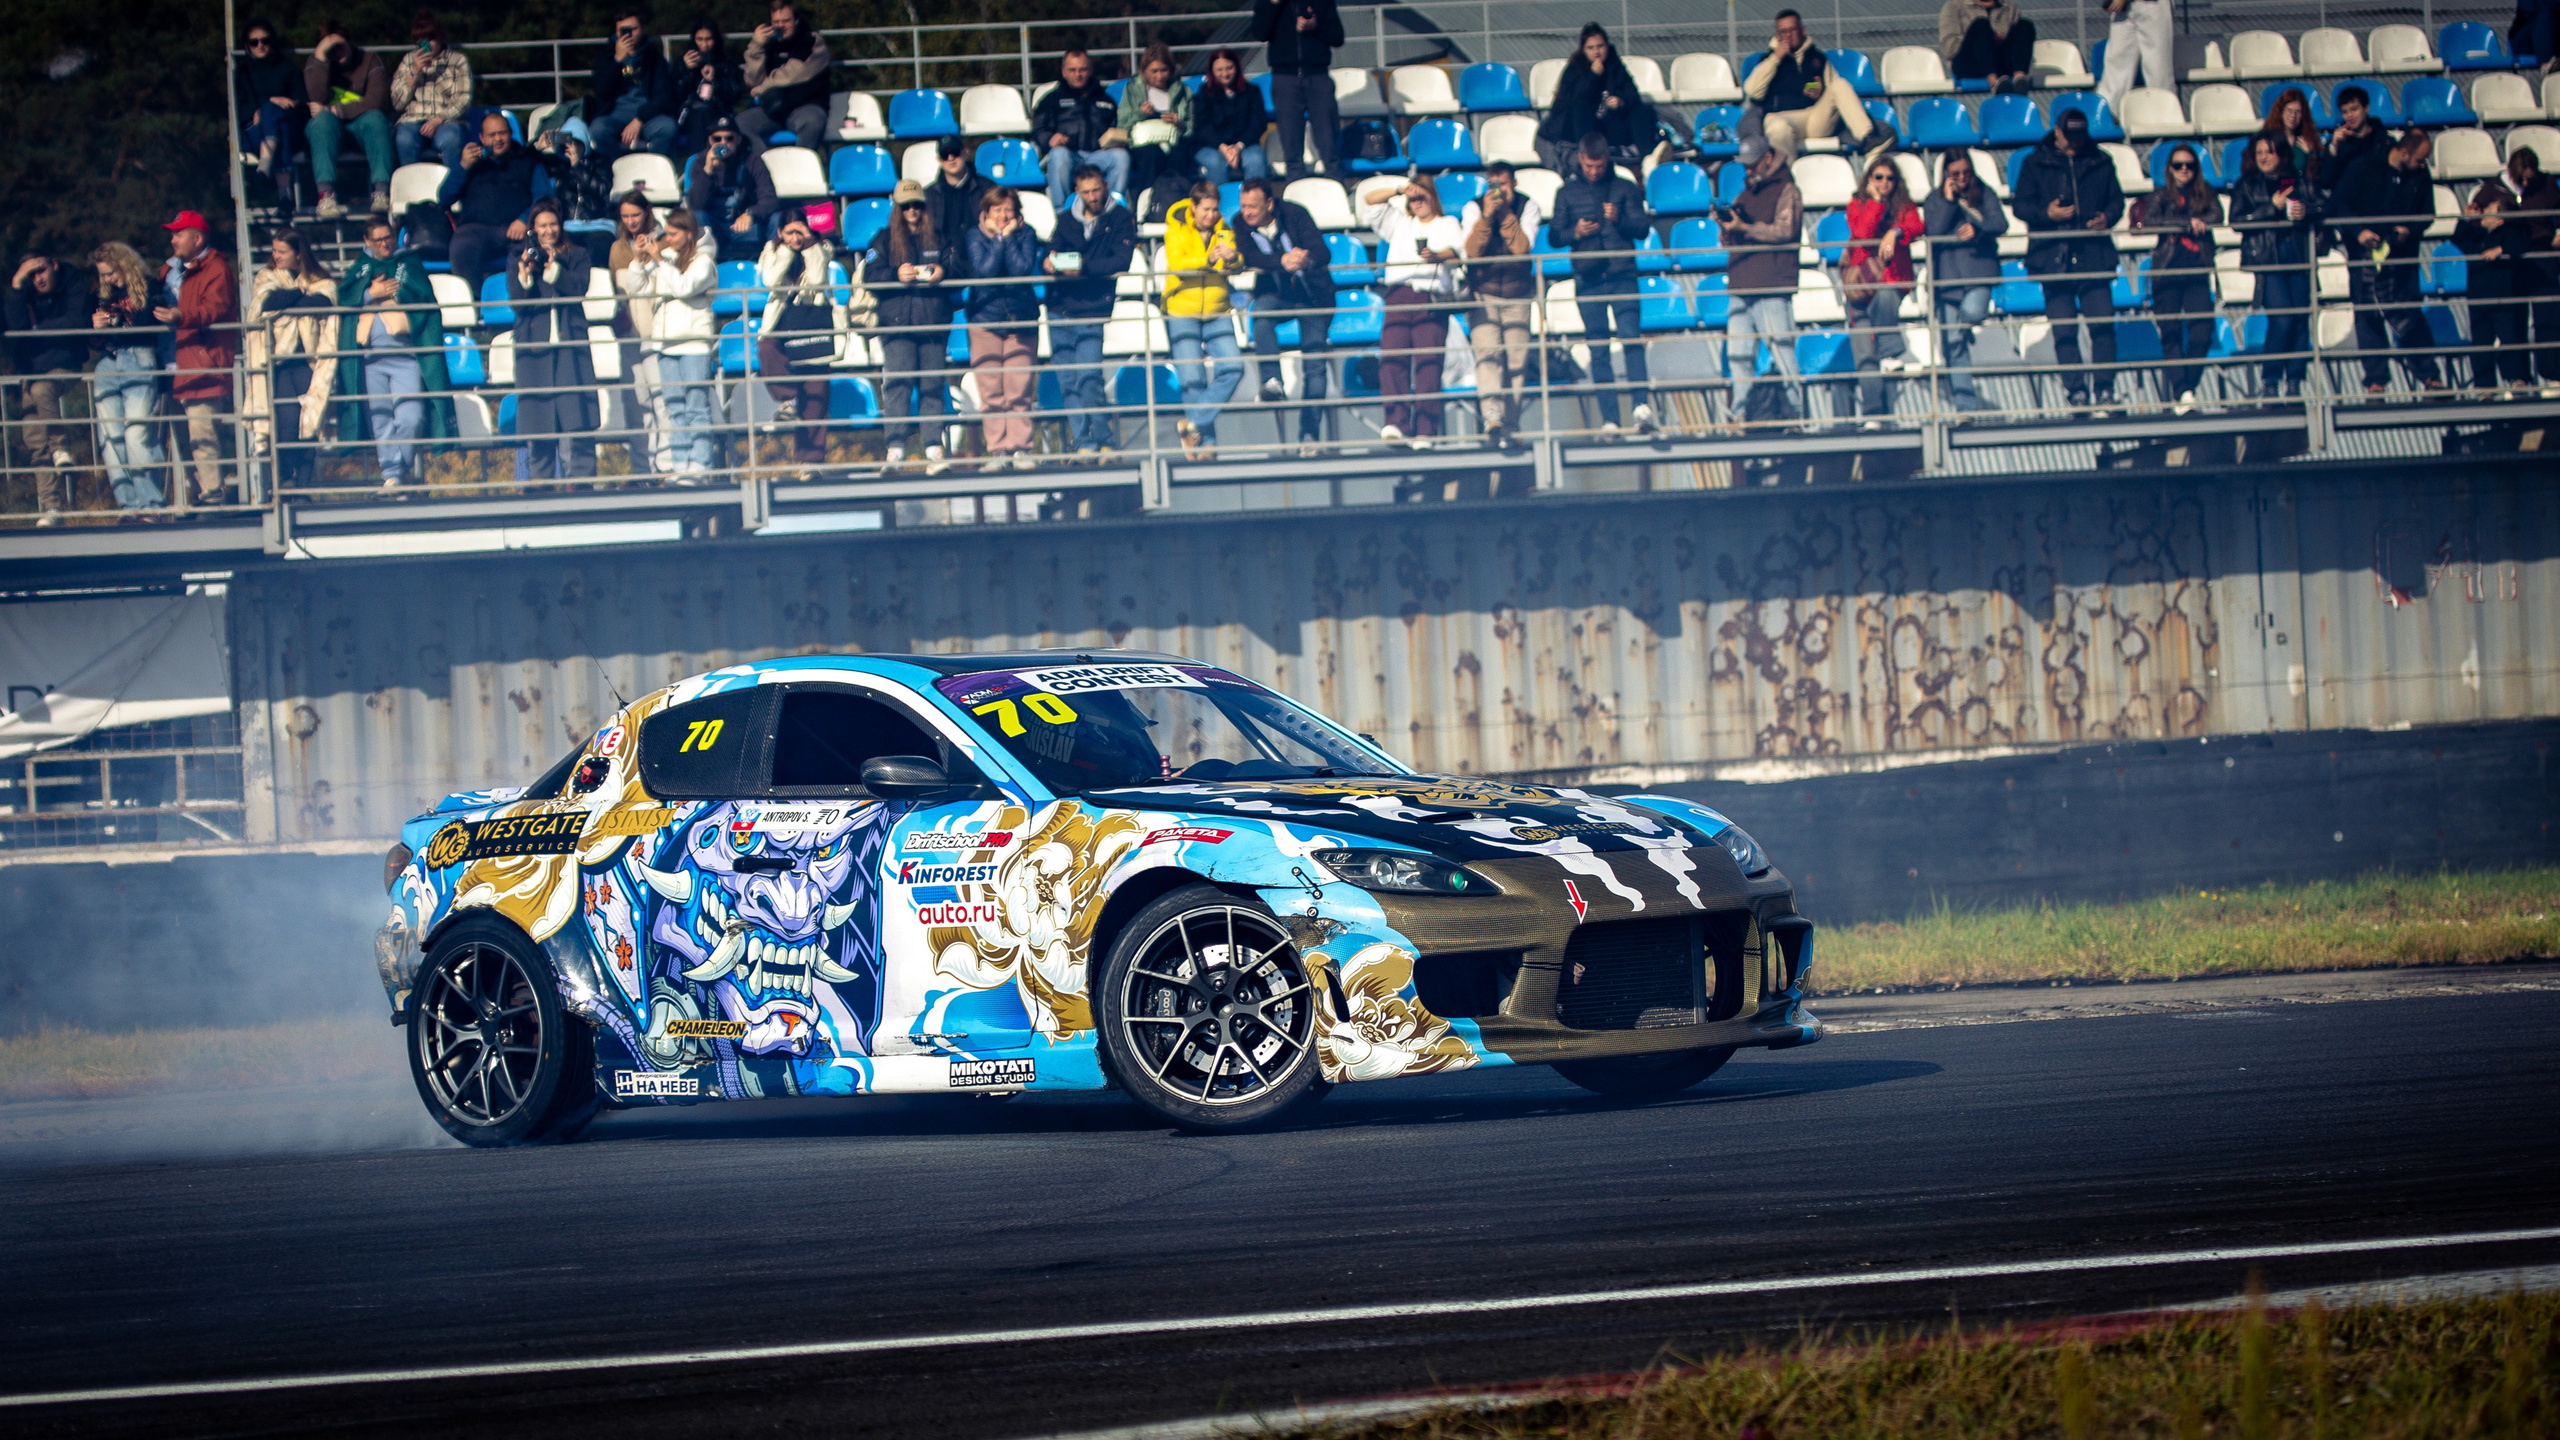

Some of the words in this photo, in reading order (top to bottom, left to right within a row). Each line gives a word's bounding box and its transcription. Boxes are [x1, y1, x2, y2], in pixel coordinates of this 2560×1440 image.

[1036, 668, 1096, 682] ADM
[1095, 666, 1170, 676] DRIFT
[1049, 674, 1187, 691] CONTEST
[971, 692, 1078, 738] 70
[607, 732, 620, 748] E
[679, 719, 724, 753] 70
[762, 811, 803, 822] ANTROPOV
[803, 811, 811, 822] S.
[813, 808, 840, 825] 70
[475, 814, 588, 842] WESTGATE
[1547, 823, 1636, 832] WESTGATE
[433, 833, 466, 859] WG
[466, 842, 575, 857] AUTOSERVICE
[898, 861, 999, 885] KINFOREST
[918, 903, 995, 925] auto.ru
[666, 1021, 746, 1036] CHAMELEON
[950, 1059, 1034, 1076] MIKOTATI
[637, 1081, 657, 1093] НА
[660, 1080, 697, 1093] НЕВЕ
[950, 1075, 992, 1086] DESIGN
[994, 1073, 1035, 1083] STUDIO
